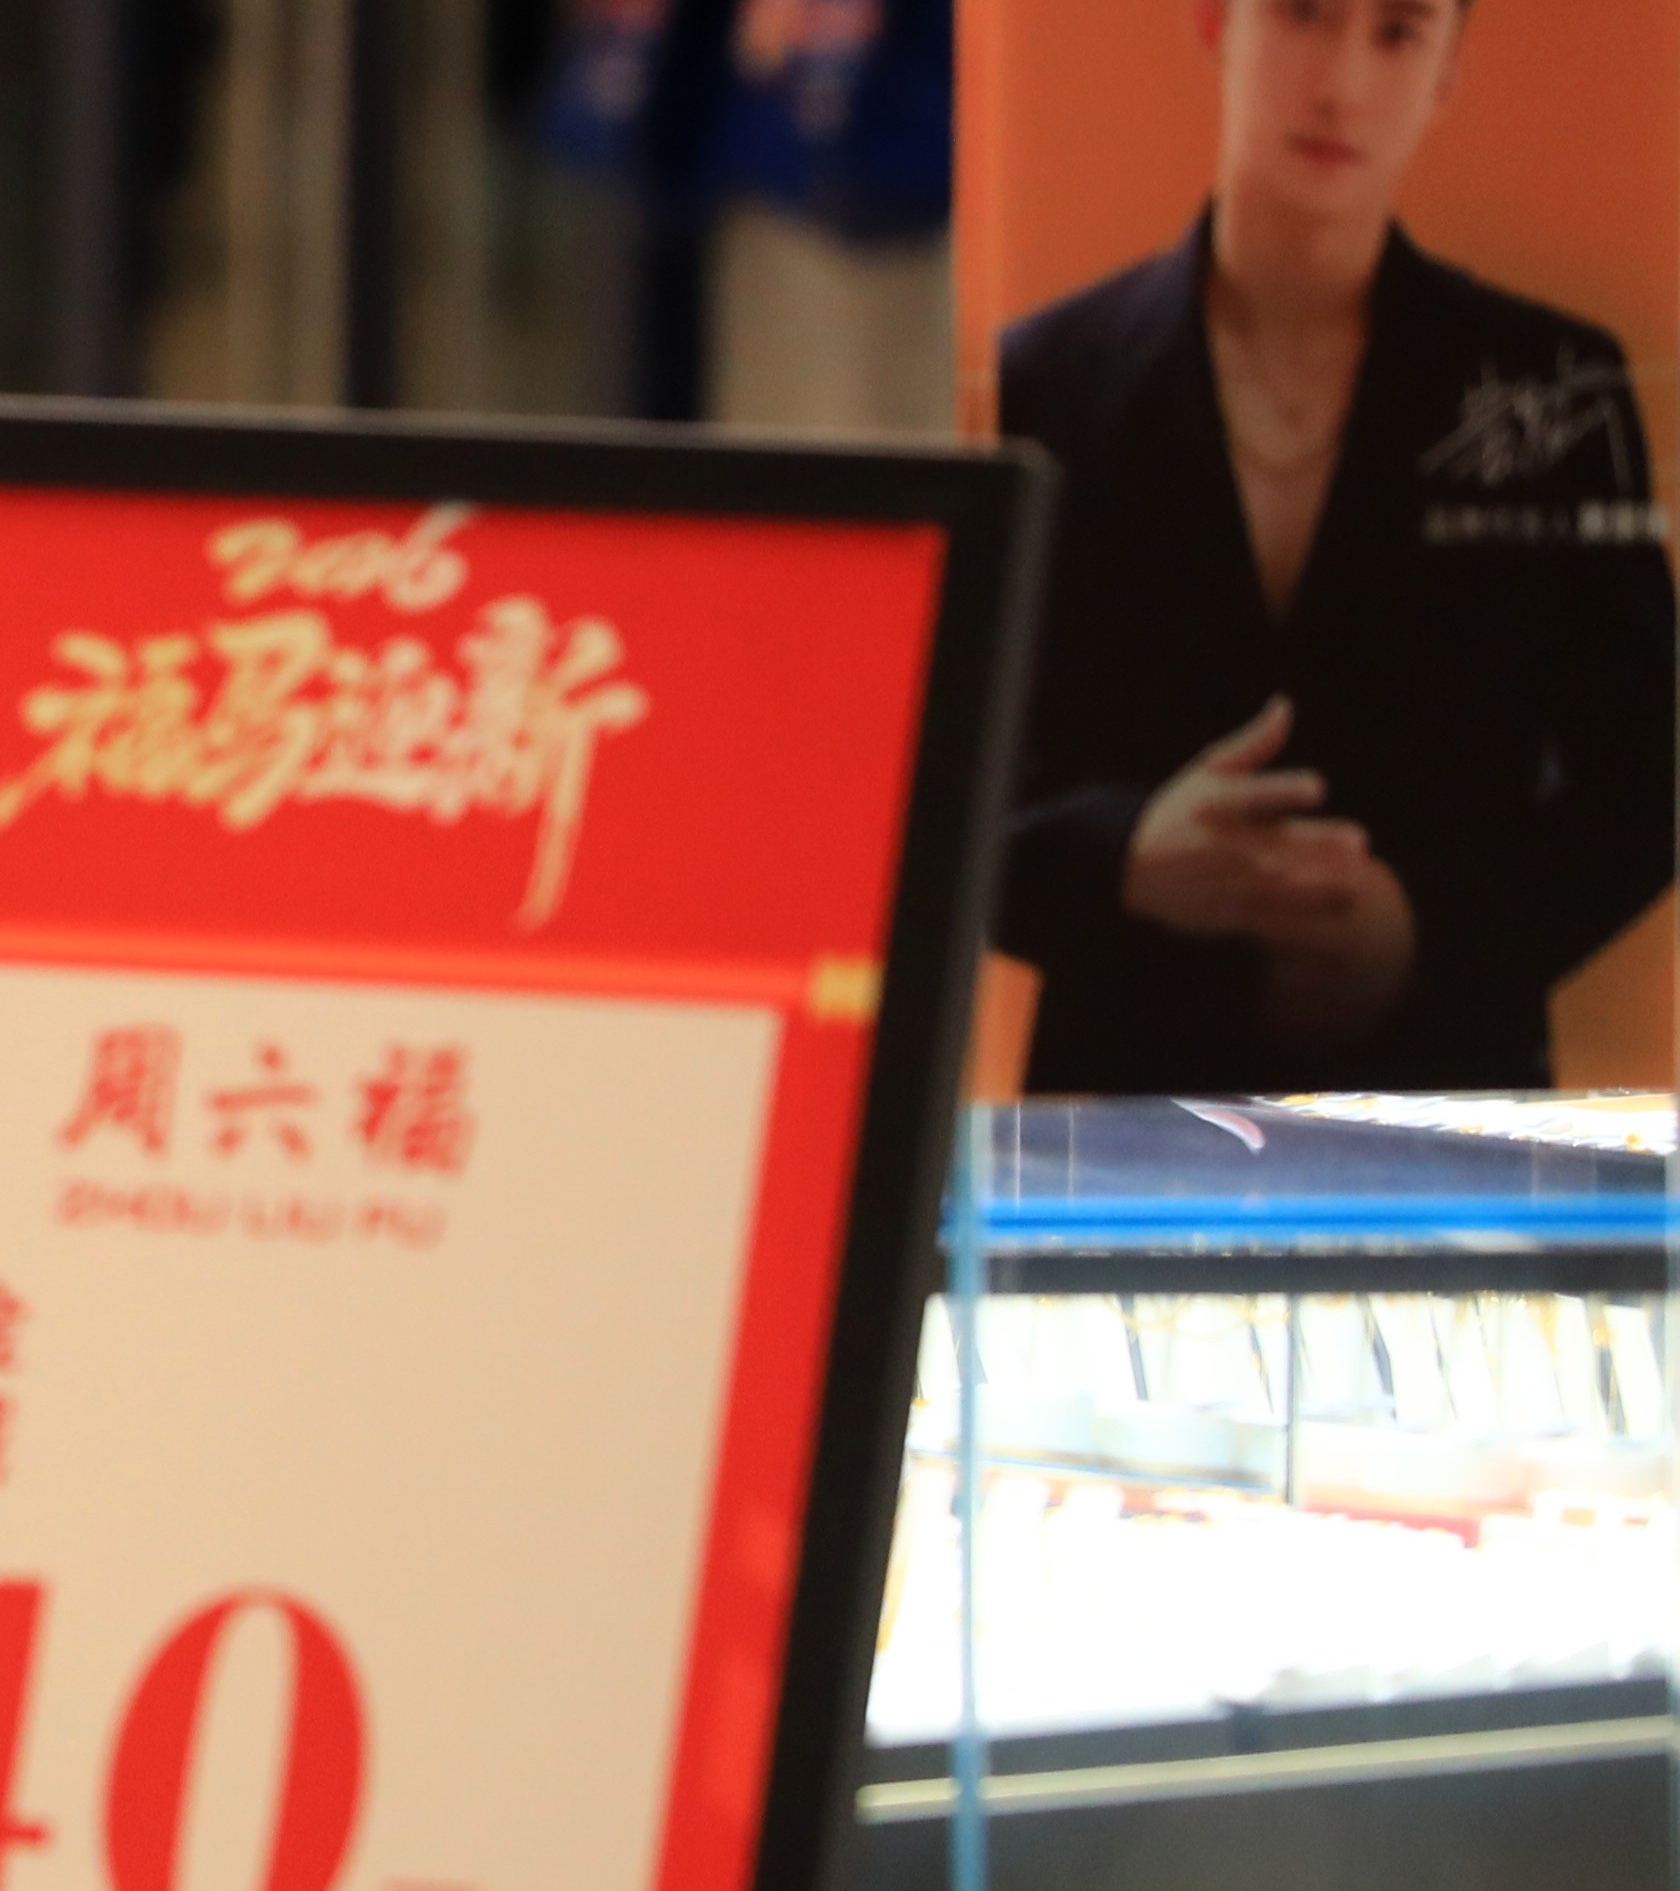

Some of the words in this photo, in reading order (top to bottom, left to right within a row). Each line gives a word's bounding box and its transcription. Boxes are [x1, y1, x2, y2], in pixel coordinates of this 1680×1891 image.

[209, 504, 474, 610] 2026
[58, 1023, 475, 1174] 周六福
